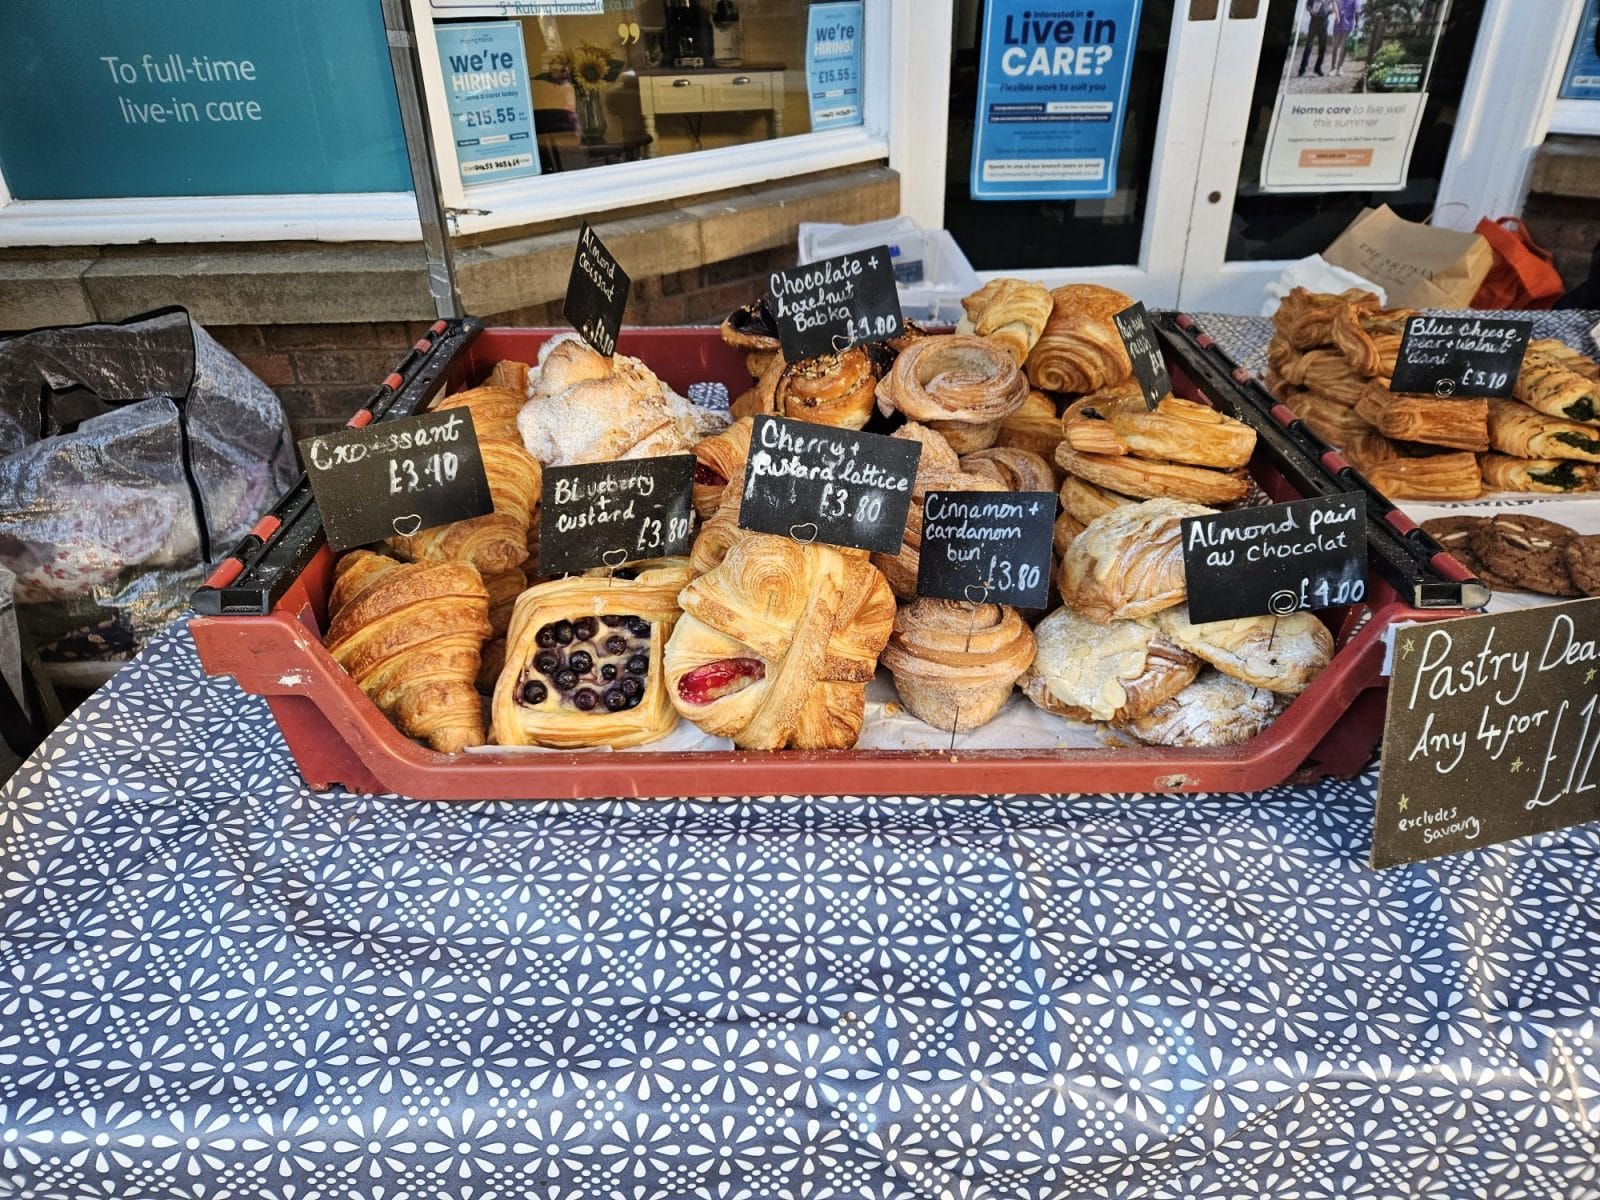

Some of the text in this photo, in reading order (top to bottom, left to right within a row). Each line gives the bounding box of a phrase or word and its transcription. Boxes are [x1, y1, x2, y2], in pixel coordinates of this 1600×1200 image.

[816, 24, 855, 41] we're
[1004, 10, 1117, 45] Live in
[449, 49, 514, 73] we're
[814, 39, 854, 56] HIRING!
[1002, 44, 1113, 77] CARE?
[100, 54, 257, 85] To full-time
[452, 69, 517, 92] HIRING!
[819, 68, 850, 83] £15.55
[1036, 83, 1058, 92] work
[1059, 83, 1069, 92] to
[1088, 84, 1106, 94] you
[118, 96, 263, 124] live-in care
[466, 107, 516, 127] £15.55
[1292, 104, 1407, 115] Home care to live well
[1313, 117, 1379, 128] this summer
[581, 226, 616, 280] Almond
[770, 255, 879, 298] Chocolate +
[777, 281, 854, 318] hazelnut
[793, 306, 852, 332] Babka
[1409, 318, 1454, 336] Blue
[1405, 337, 1445, 354] pear
[1446, 341, 1455, 349] +
[761, 419, 861, 466] Cherry +
[838, 459, 909, 492] lattice
[557, 500, 636, 533] custard
[597, 495, 611, 510] +
[820, 482, 881, 523] £3.80
[925, 493, 1039, 521] Cinnamon +
[637, 516, 688, 551] £3.80
[925, 520, 1022, 540] cardamom
[1188, 506, 1300, 551] Almond
[946, 543, 981, 562] bun
[1206, 549, 1235, 567] au
[986, 555, 1041, 592] £3.80
[1300, 576, 1366, 609] £4.00
[1408, 613, 1600, 711] Pastry Dea
[1408, 712, 1467, 774] Any
[1477, 705, 1501, 750] 4
[1490, 709, 1549, 760] for
[1398, 806, 1458, 832] excludes
